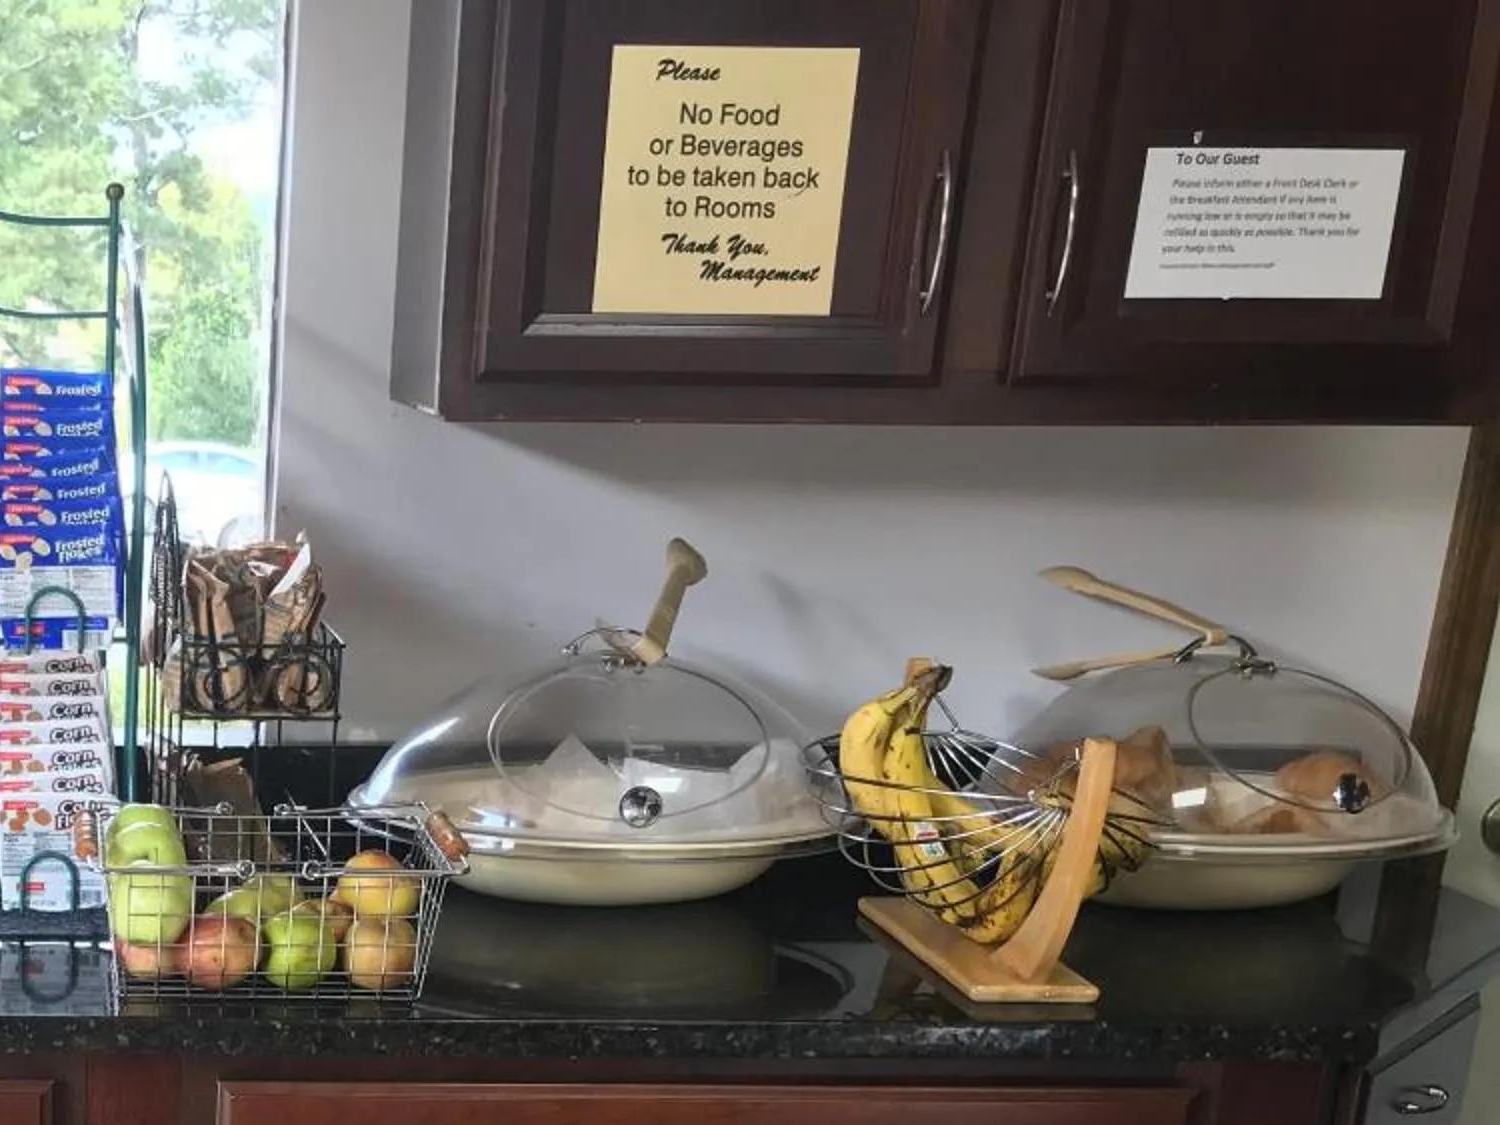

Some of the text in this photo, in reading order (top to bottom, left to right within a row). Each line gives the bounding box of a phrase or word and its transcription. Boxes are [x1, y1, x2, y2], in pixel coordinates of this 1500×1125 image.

[655, 58, 721, 82] Please
[679, 102, 781, 126] No Food
[649, 134, 804, 162] or Beverages
[1177, 153, 1260, 166] To Our Guest
[627, 165, 820, 190] to be taken back
[665, 196, 776, 219] to Rooms
[661, 233, 720, 255] Thank
[699, 259, 821, 288] Management
[56, 419, 103, 434] Frosted
[52, 459, 99, 477] Frosted
[57, 482, 106, 499] Frosted
[61, 506, 110, 523] Frosted
[46, 657, 87, 673] Corn
[48, 679, 90, 695] Corn
[50, 702, 92, 718] Corn
[50, 726, 93, 743] Corn
[52, 750, 95, 767] Corn
[52, 774, 96, 792] Corn
